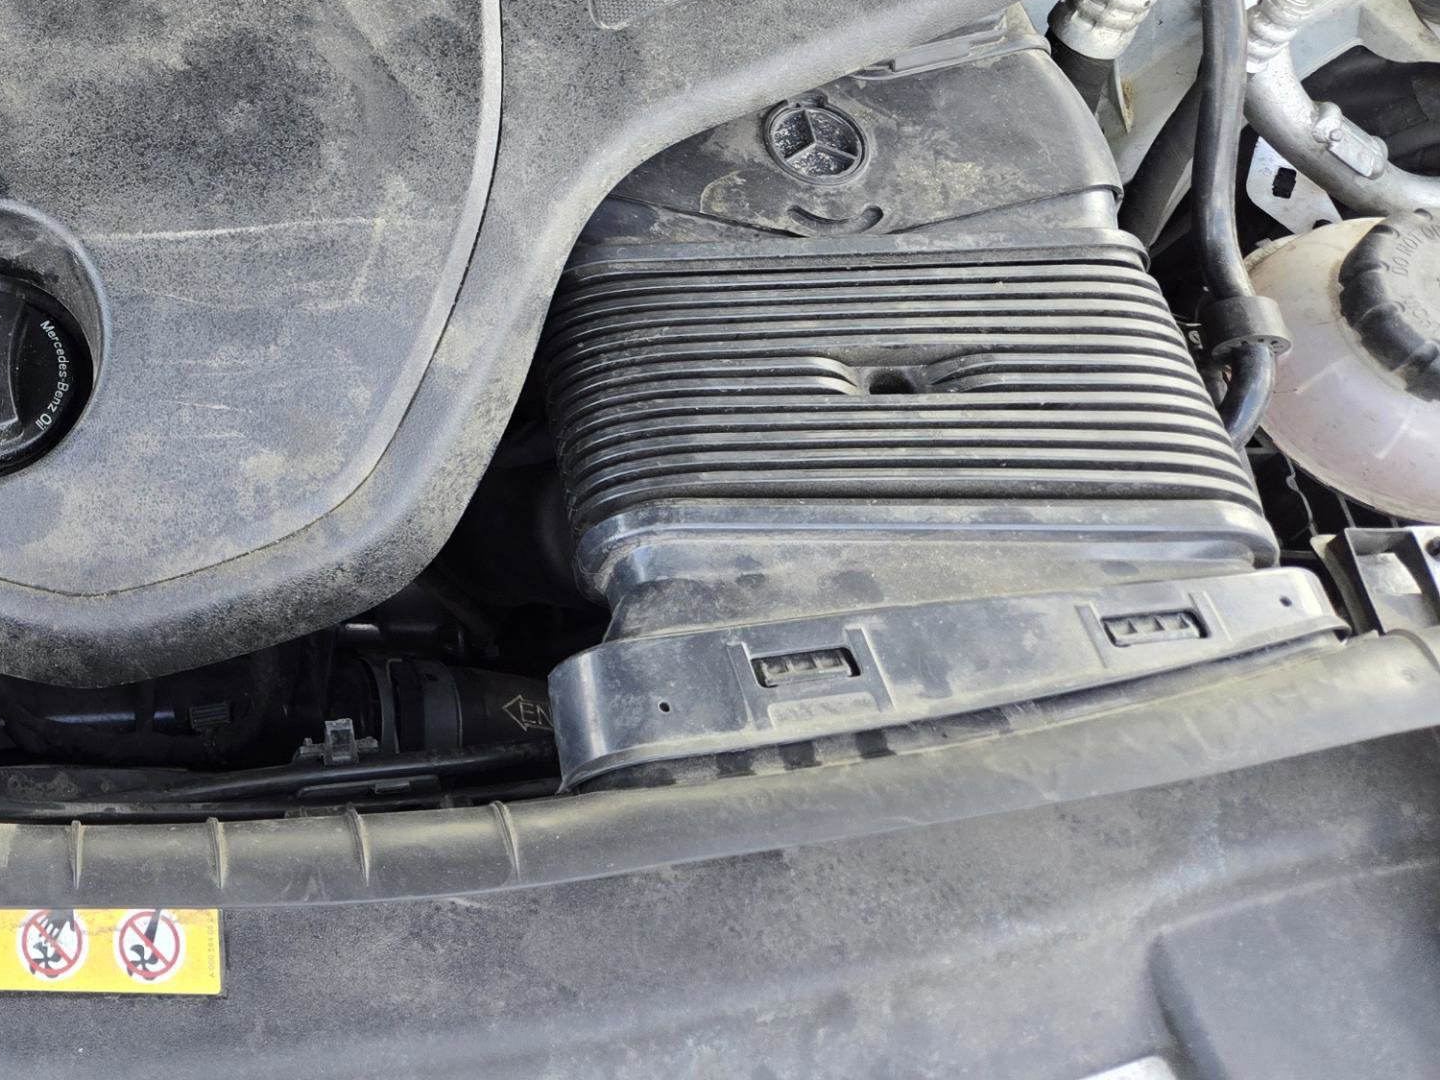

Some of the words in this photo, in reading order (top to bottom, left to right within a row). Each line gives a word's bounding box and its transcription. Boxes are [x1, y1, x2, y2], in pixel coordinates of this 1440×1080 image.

[1395, 230, 1423, 257] NOT
[1391, 256, 1409, 276] DO
[39, 320, 70, 412] Mercedes-Benz
[35, 412, 53, 430] Oil
